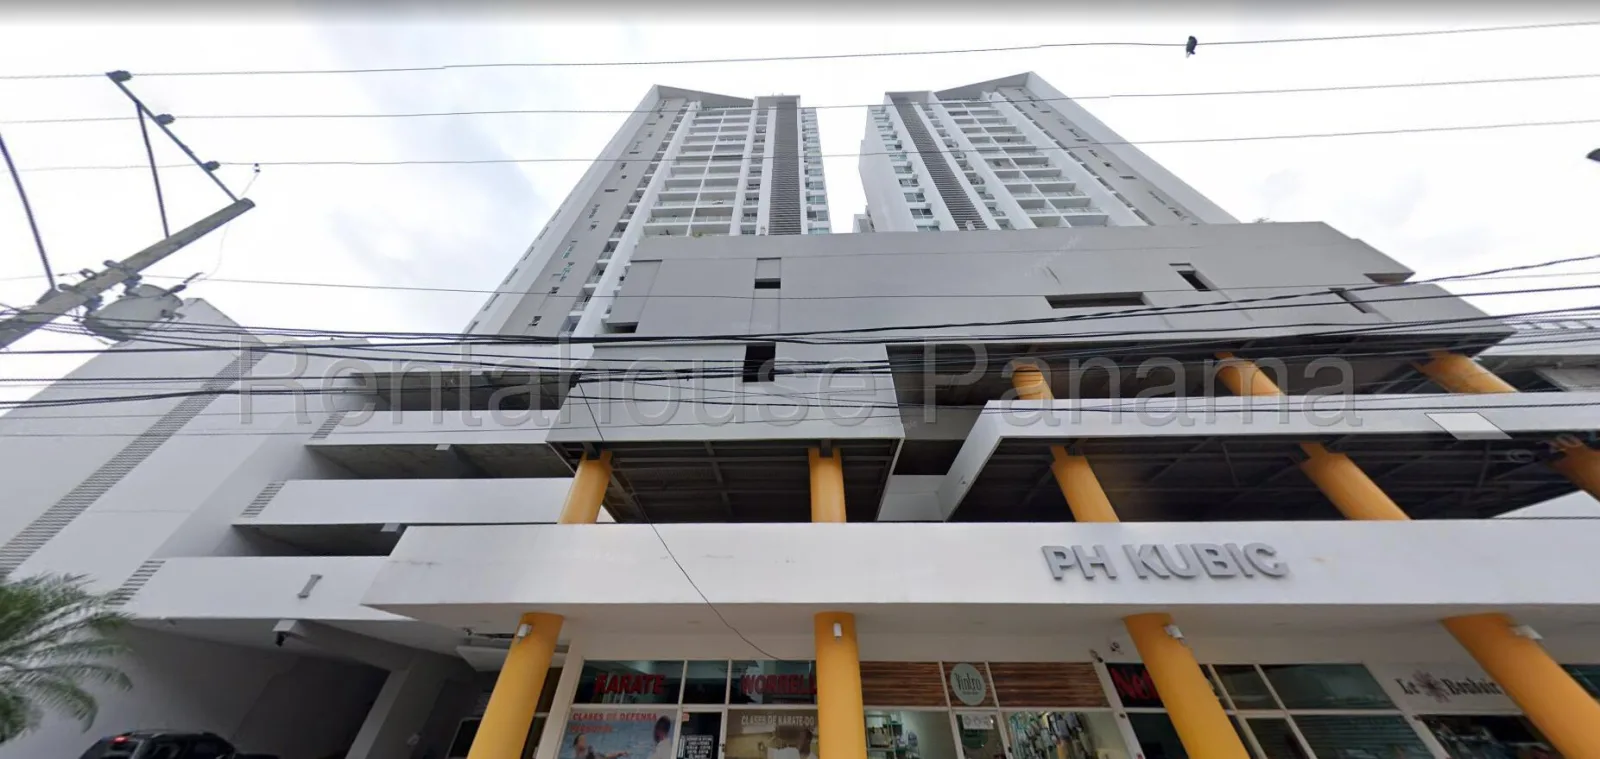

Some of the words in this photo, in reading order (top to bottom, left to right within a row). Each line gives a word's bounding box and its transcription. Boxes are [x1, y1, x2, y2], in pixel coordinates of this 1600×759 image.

[1041, 545, 1118, 580] PH
[1122, 542, 1290, 580] KUBIC
[594, 674, 667, 695] KARATE
[741, 715, 767, 725] CLASES
